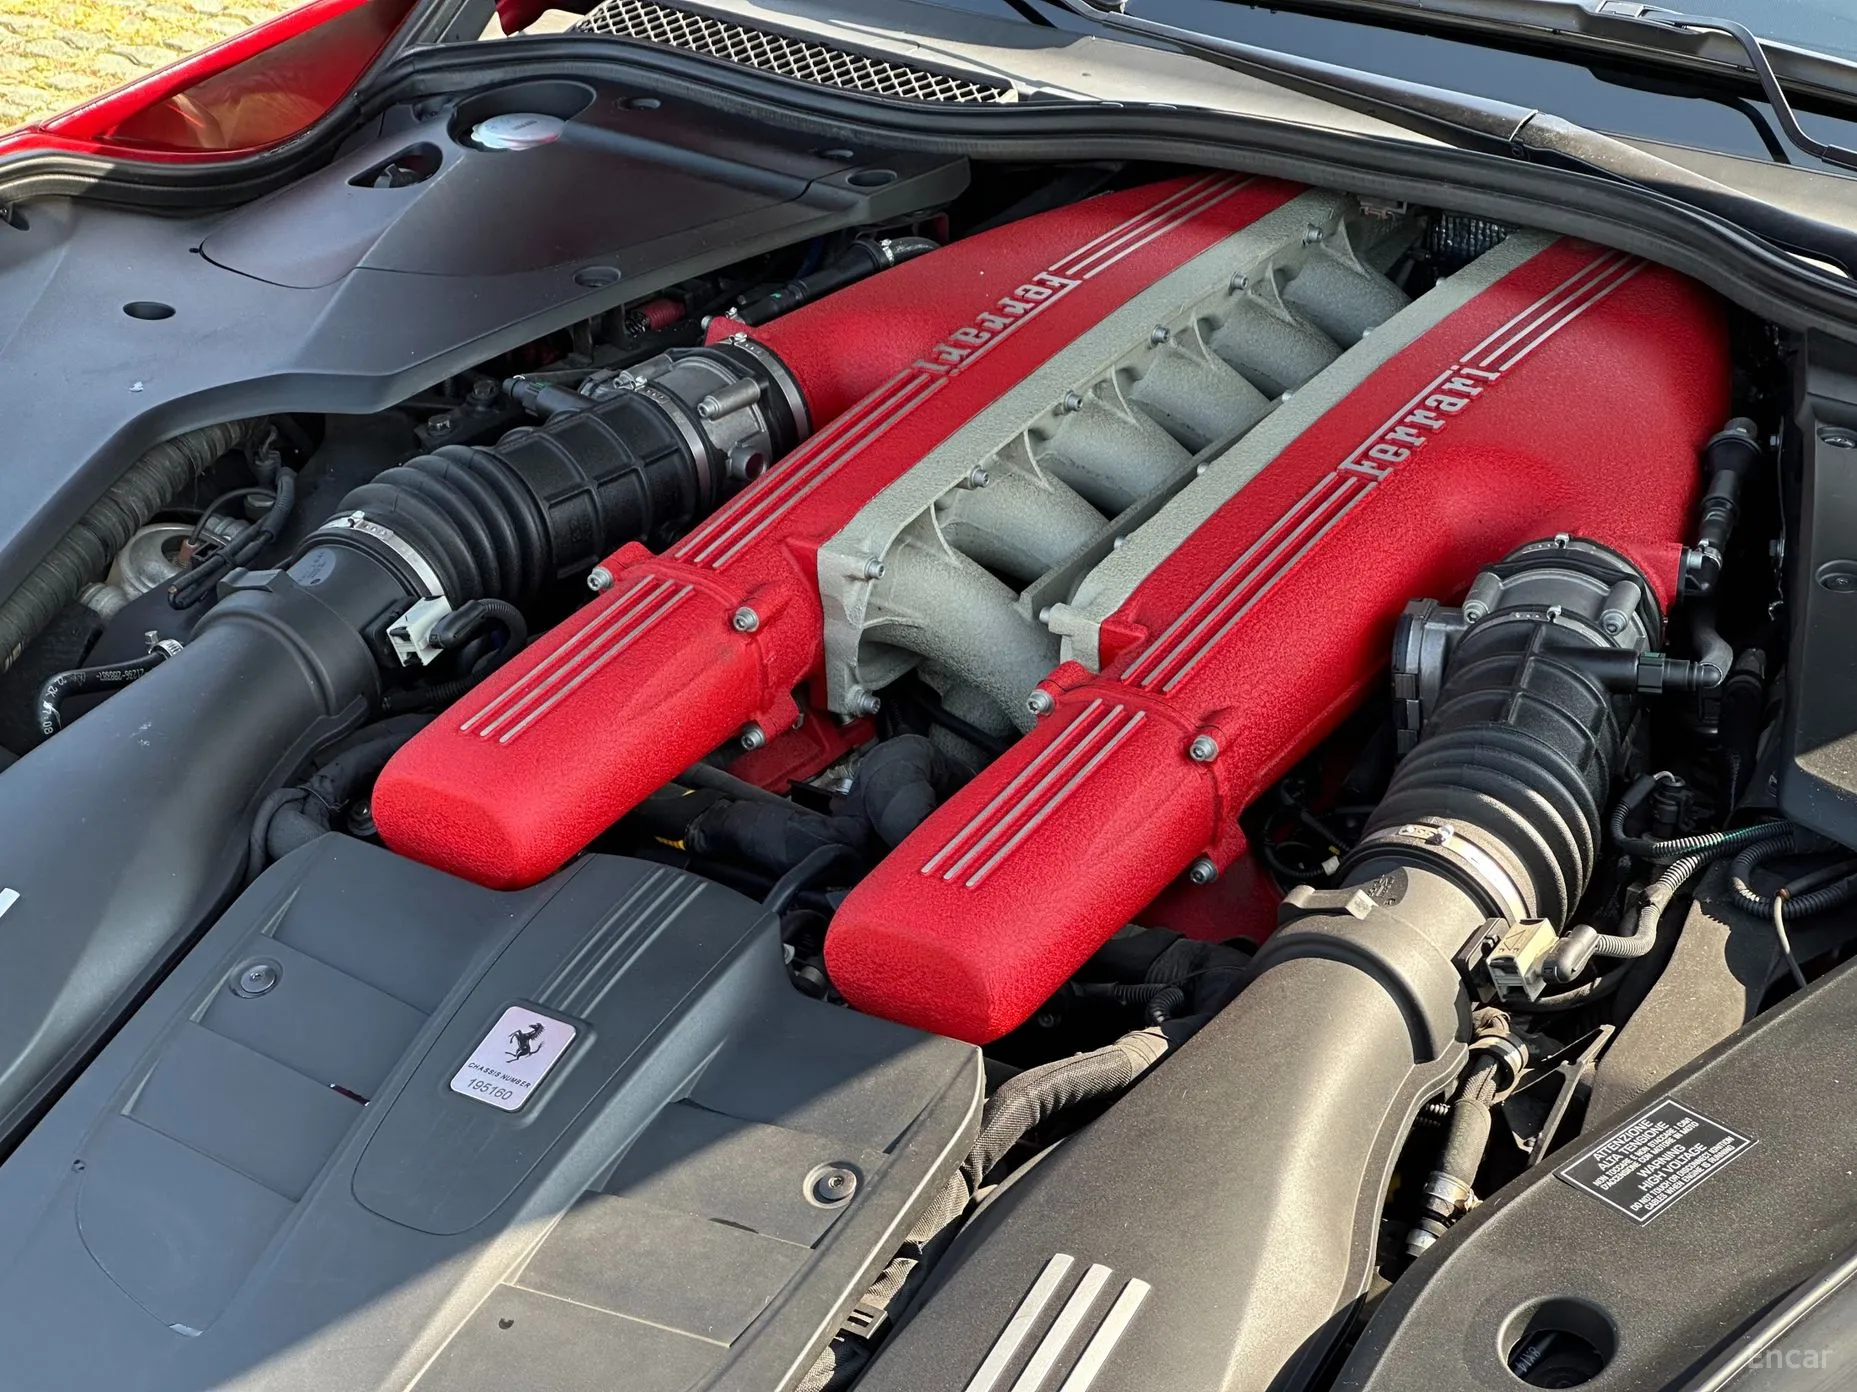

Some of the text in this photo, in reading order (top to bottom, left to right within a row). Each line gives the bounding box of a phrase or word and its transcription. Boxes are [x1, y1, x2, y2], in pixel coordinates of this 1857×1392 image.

[911, 271, 1083, 376] Ferrari
[1337, 365, 1501, 482] Ferrari
[467, 1062, 531, 1089] CHASSIS NUMBER
[467, 1078, 513, 1101] 195160
[1593, 1119, 1653, 1161] ATTENZIONE
[1598, 1121, 1670, 1171] ALTA TENSIONE
[1605, 1158, 1633, 1177] TOCCARE
[1634, 1145, 1650, 1156] NON
[1647, 1128, 1678, 1148] STACCARE
[1636, 1144, 1686, 1178] WARNING
[1638, 1152, 1654, 1163] CON
[1650, 1136, 1676, 1155] MOTORE
[1672, 1131, 1683, 1140] IN
[1680, 1121, 1700, 1135] MOTO
[1630, 1135, 1735, 1211] DO NOT TOUCH OR DISCONNECT IGNITION
[1638, 1142, 1708, 1191] HIGH VOLTAGE
[1644, 1192, 1668, 1210] CABLES
[1664, 1181, 1685, 1195] WHEN
[1681, 1166, 1705, 1182] ENGINE
[1707, 1144, 1736, 1164] RUNNING
